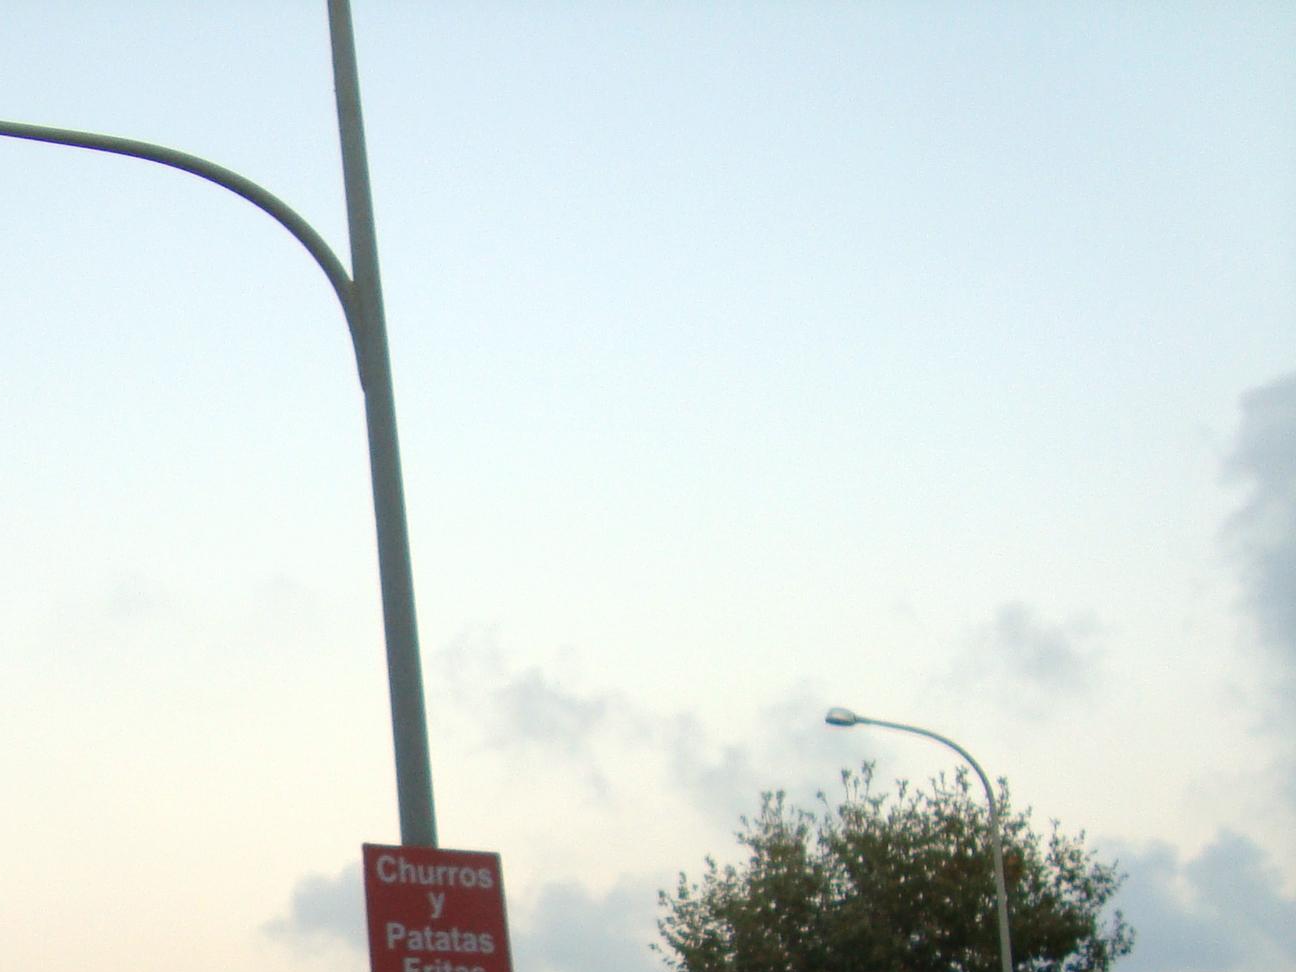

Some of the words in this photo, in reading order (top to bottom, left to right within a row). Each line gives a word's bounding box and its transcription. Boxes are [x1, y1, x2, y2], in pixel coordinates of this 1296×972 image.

[376, 855, 494, 888] Churros
[427, 891, 446, 919] y
[386, 922, 495, 953] Patatas
